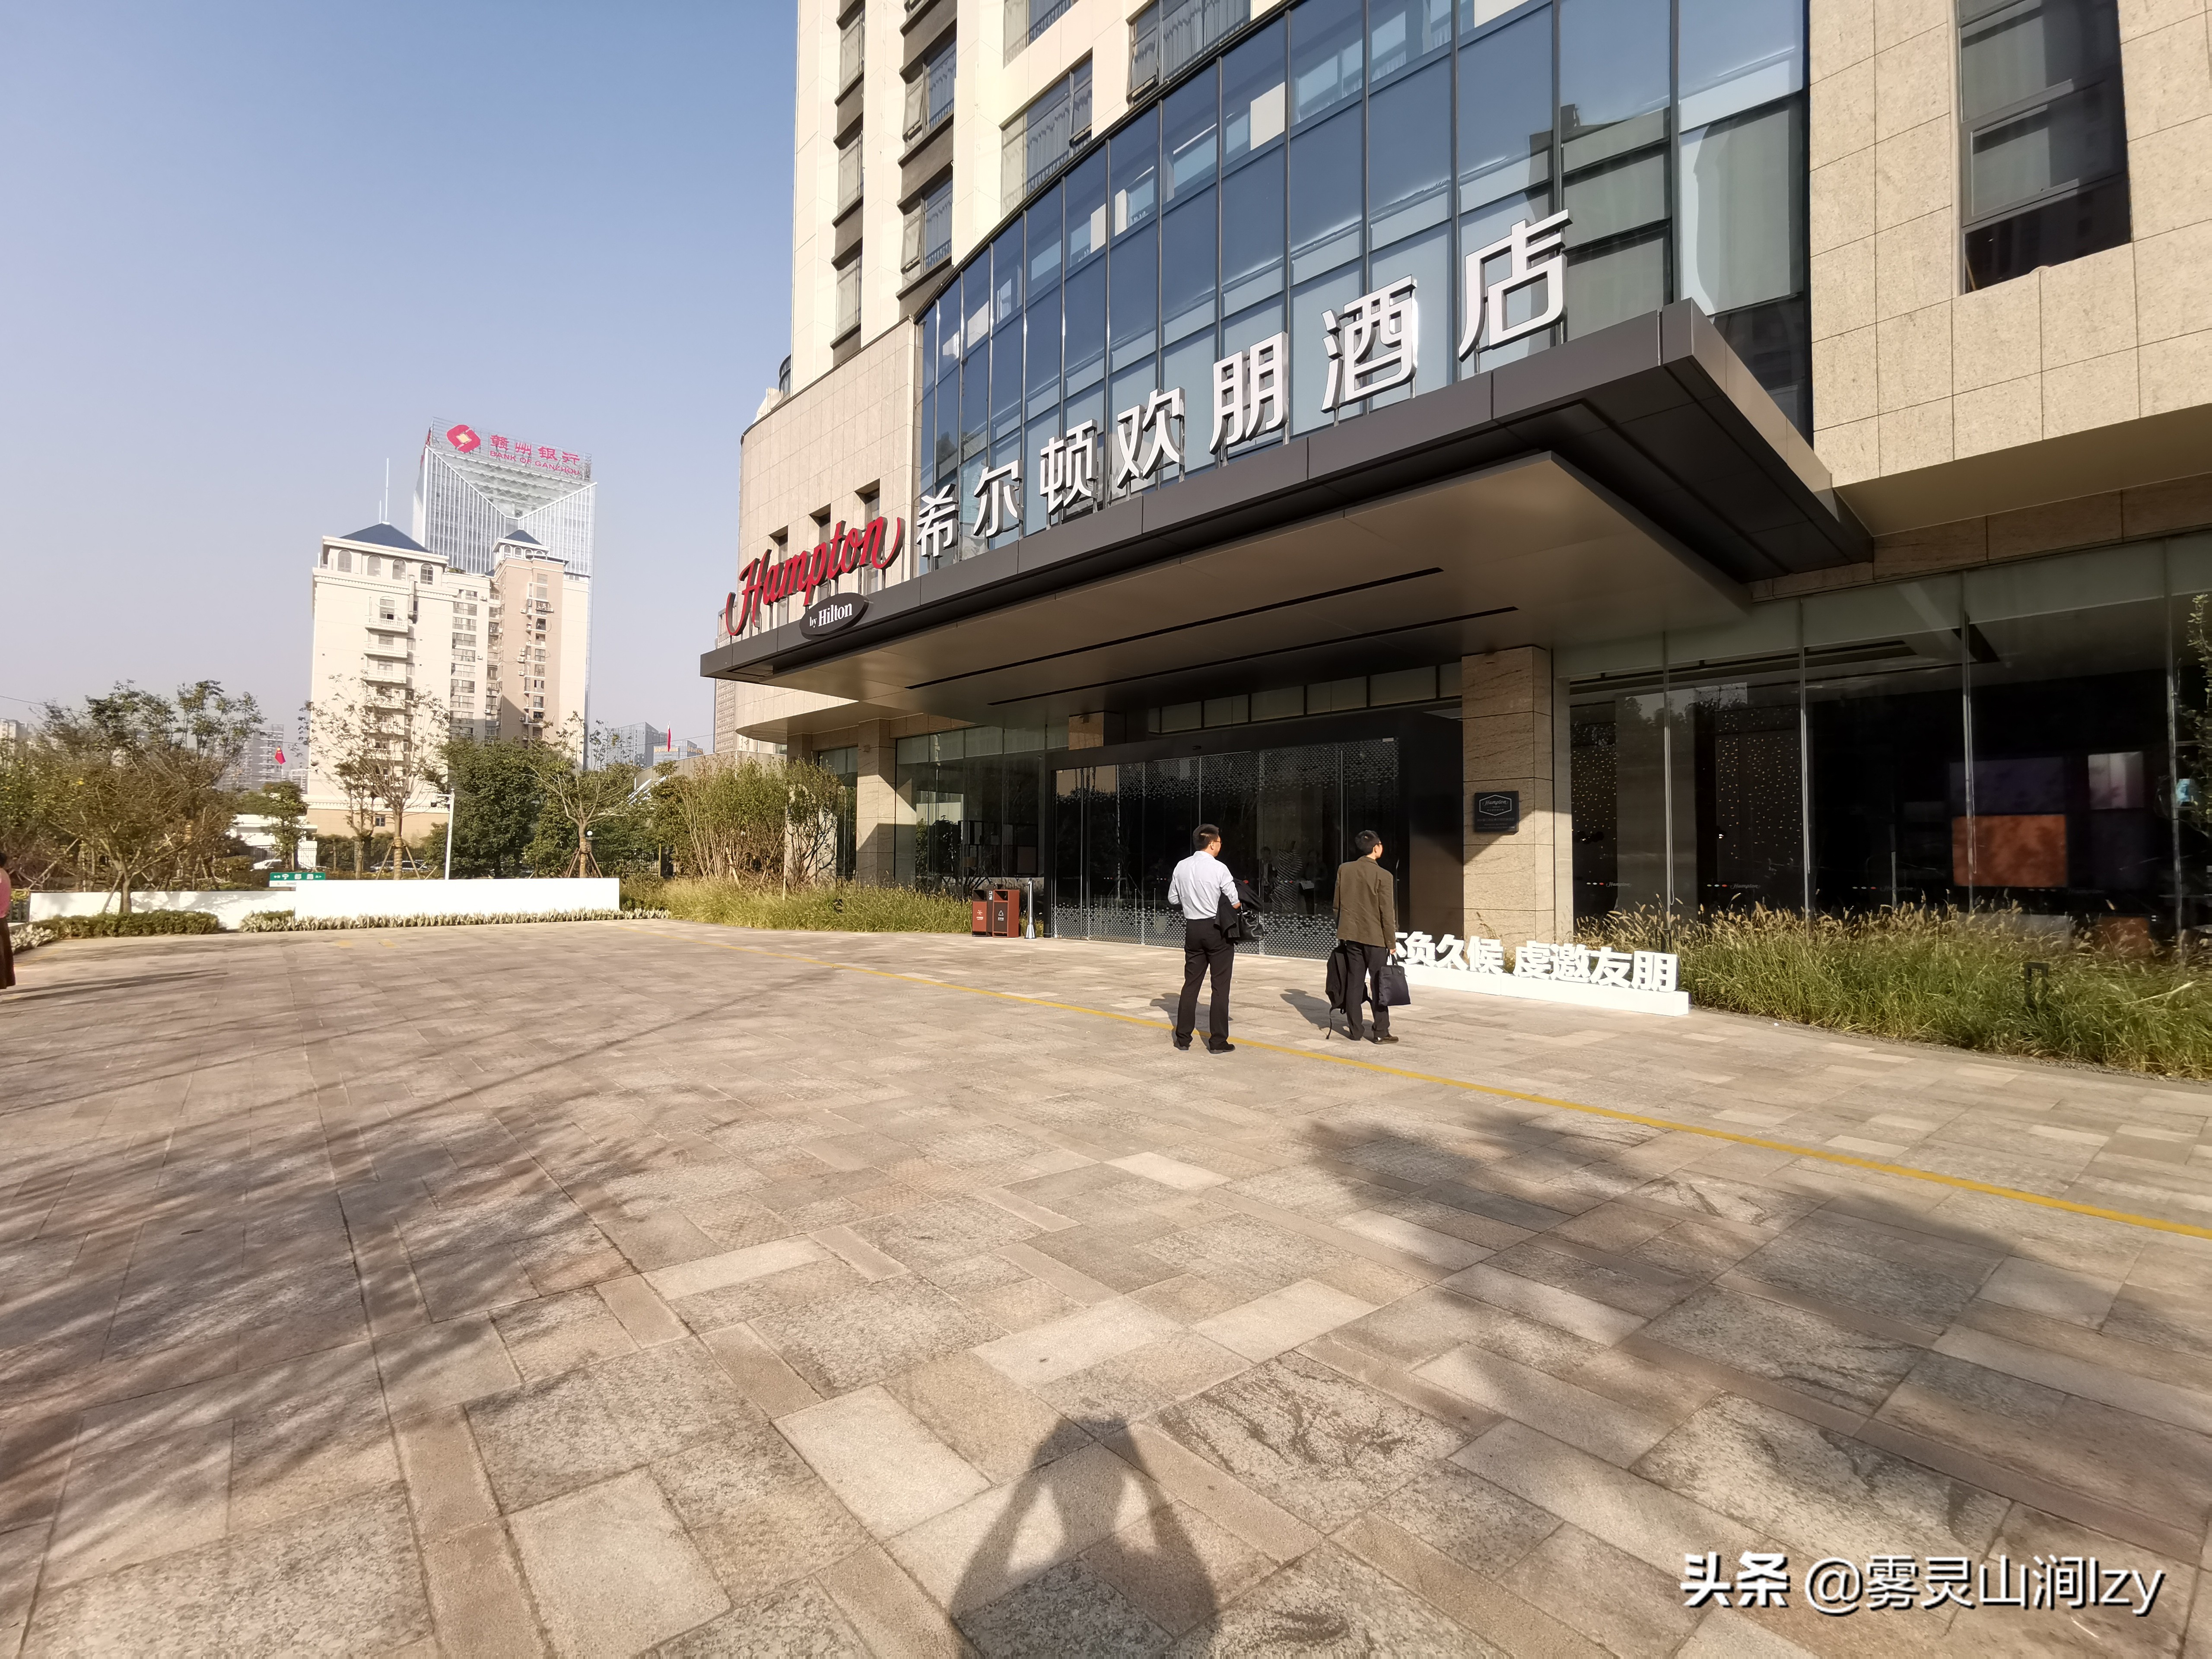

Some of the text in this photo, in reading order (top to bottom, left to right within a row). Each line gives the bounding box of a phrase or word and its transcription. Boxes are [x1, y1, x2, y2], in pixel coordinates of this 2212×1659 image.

[915, 208, 1572, 557] 希尔顿欢朋酒店
[490, 435, 580, 465] 赣州银行
[490, 451, 516, 462] BANK
[534, 461, 580, 475] GANZHOU
[726, 516, 906, 636] Hampton
[809, 603, 852, 628] by Hilton
[1513, 941, 1679, 992] 虔邀友朋
